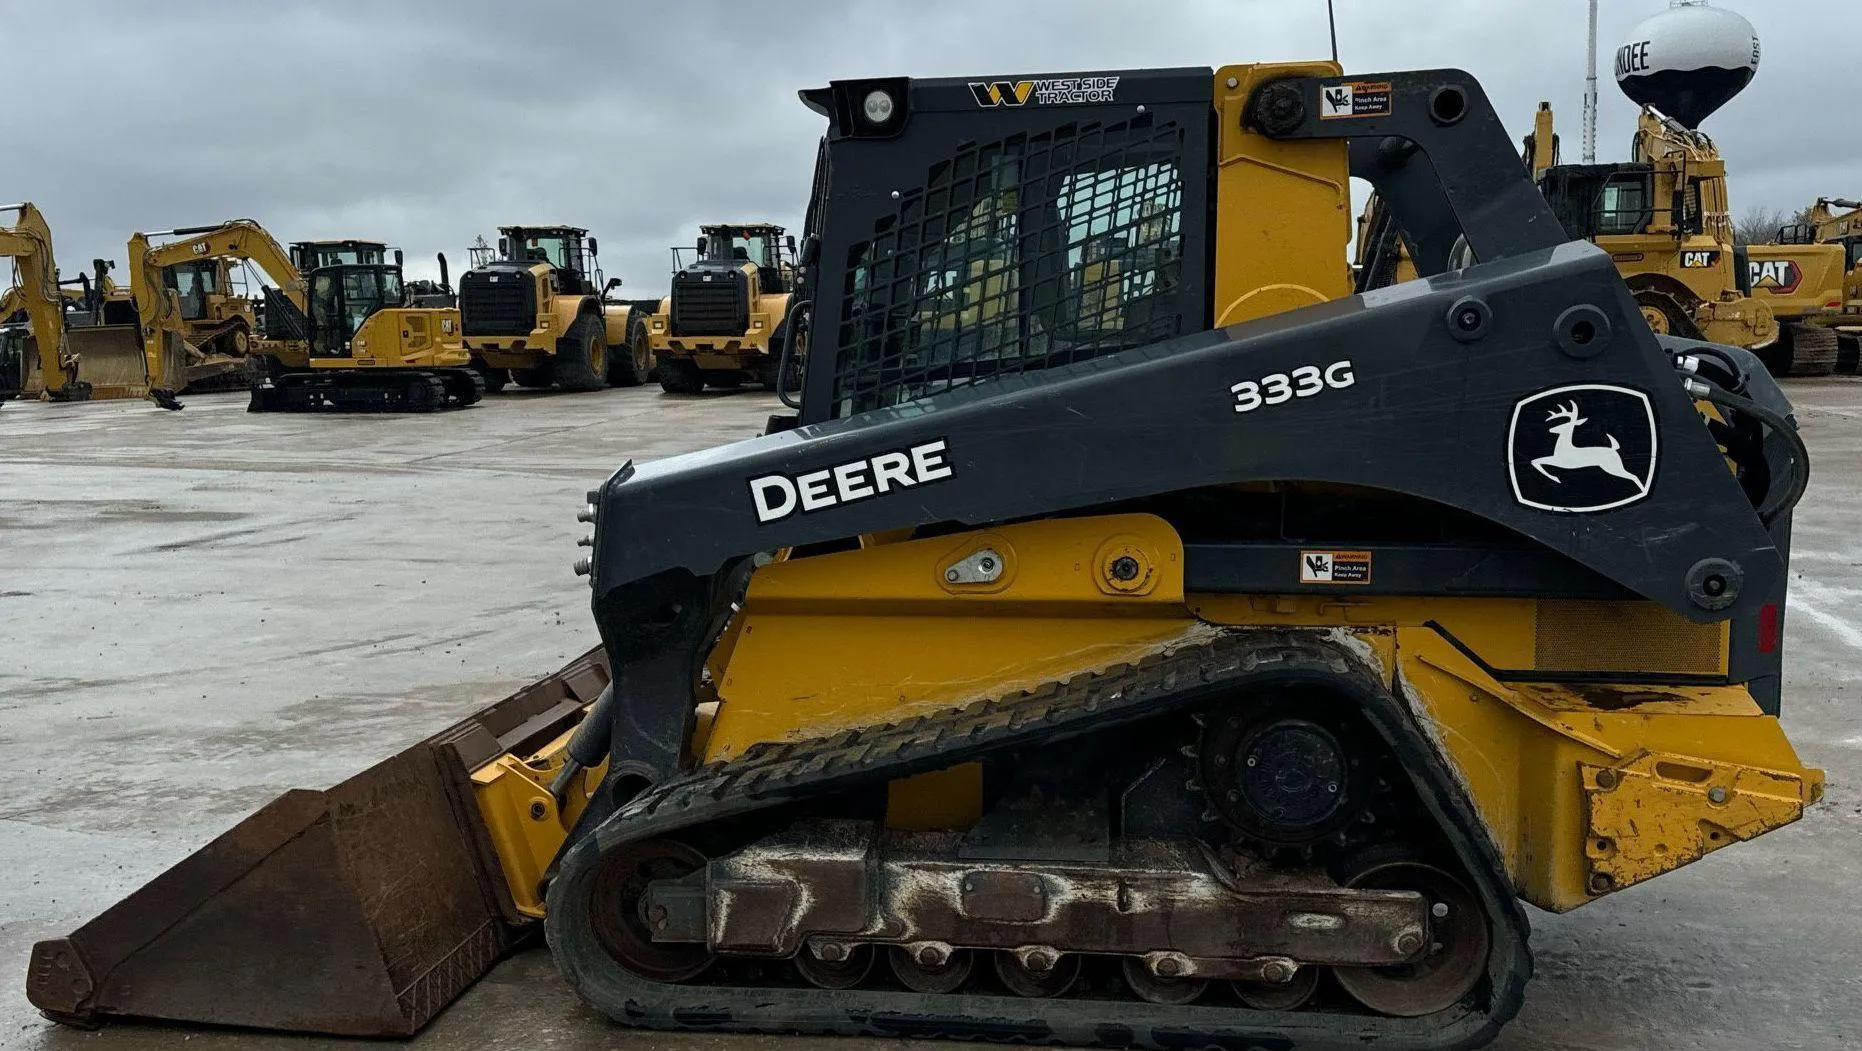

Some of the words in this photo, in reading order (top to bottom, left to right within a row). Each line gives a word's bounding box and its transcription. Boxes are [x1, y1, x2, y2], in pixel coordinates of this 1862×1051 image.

[1036, 79, 1080, 92] WEST
[1082, 77, 1119, 90] SIDE
[1036, 89, 1113, 104] TRACTOR
[1684, 252, 1710, 267] CAT
[1749, 261, 1789, 288] CAT
[1231, 361, 1355, 412] 333G
[750, 440, 952, 523] DEERE
